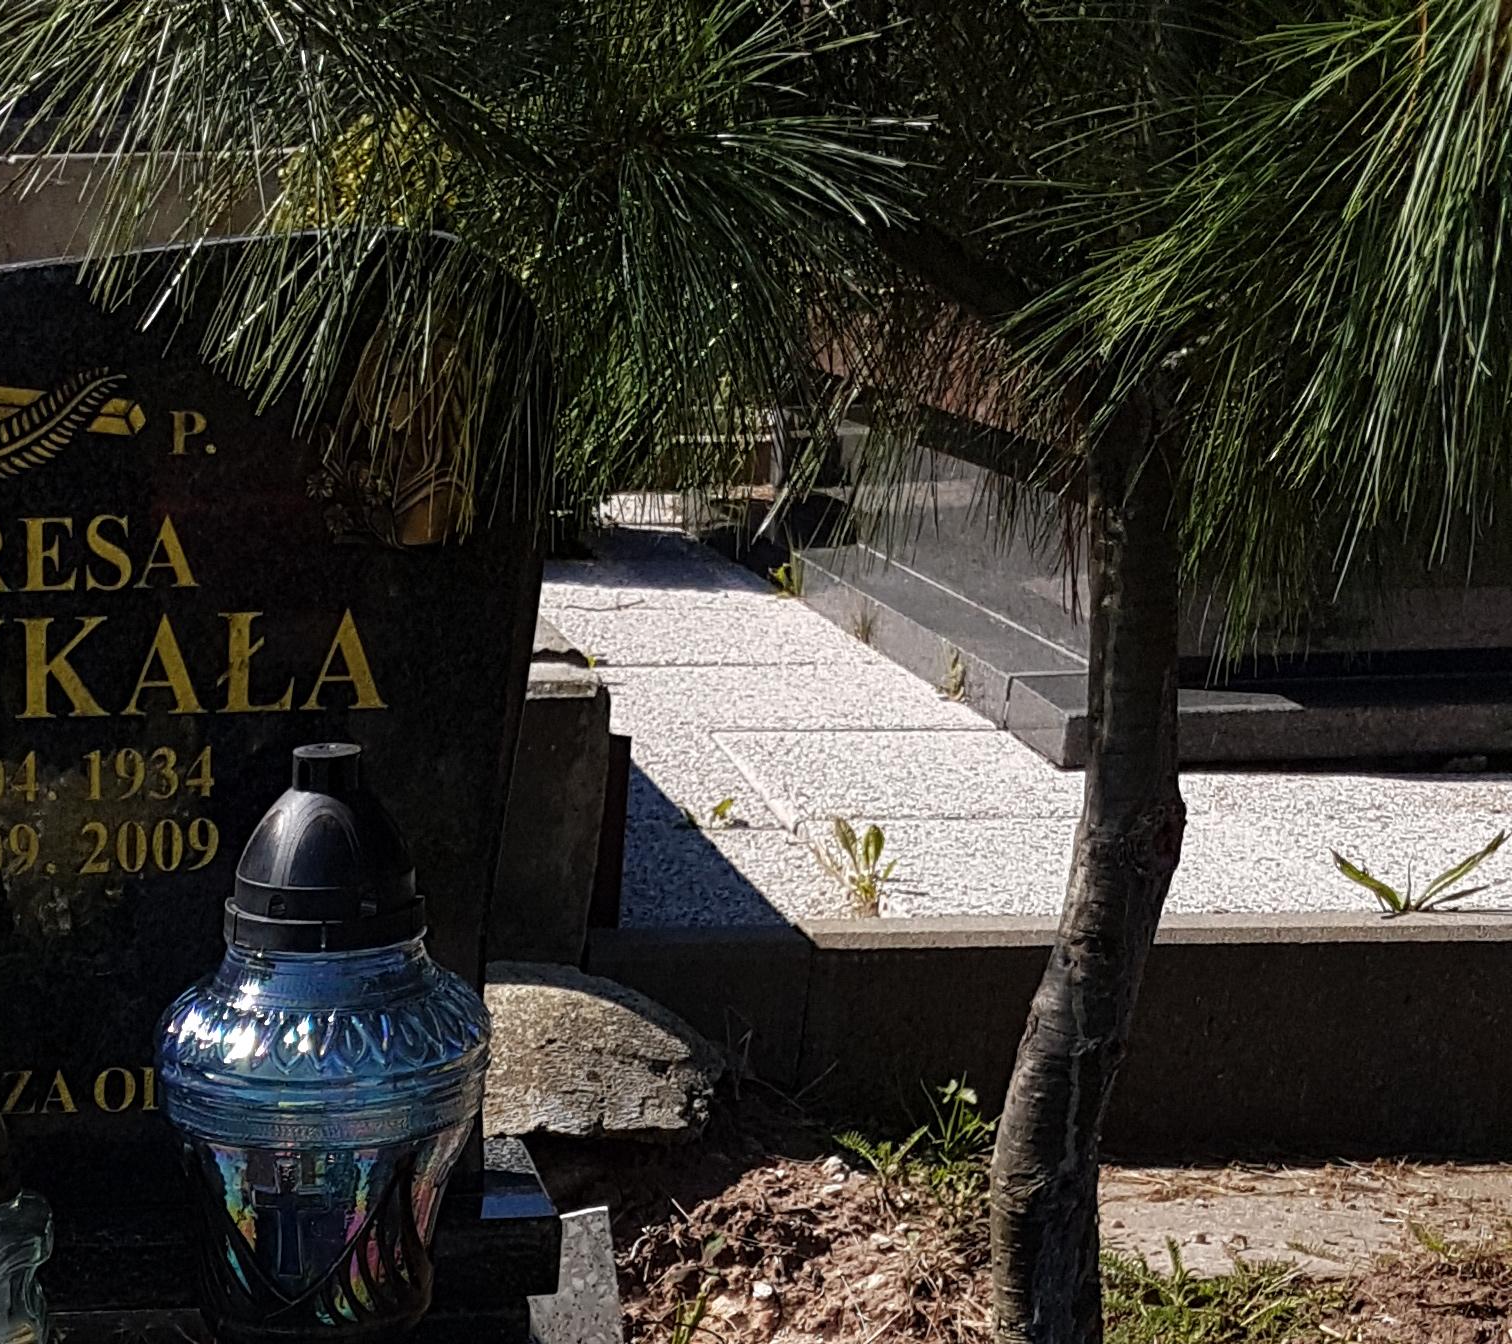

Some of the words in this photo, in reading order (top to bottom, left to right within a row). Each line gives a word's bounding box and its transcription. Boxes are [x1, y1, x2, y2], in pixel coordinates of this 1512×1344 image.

[169, 409, 217, 456] P.
[86, 743, 215, 800] 1934
[80, 816, 221, 874] 2009
